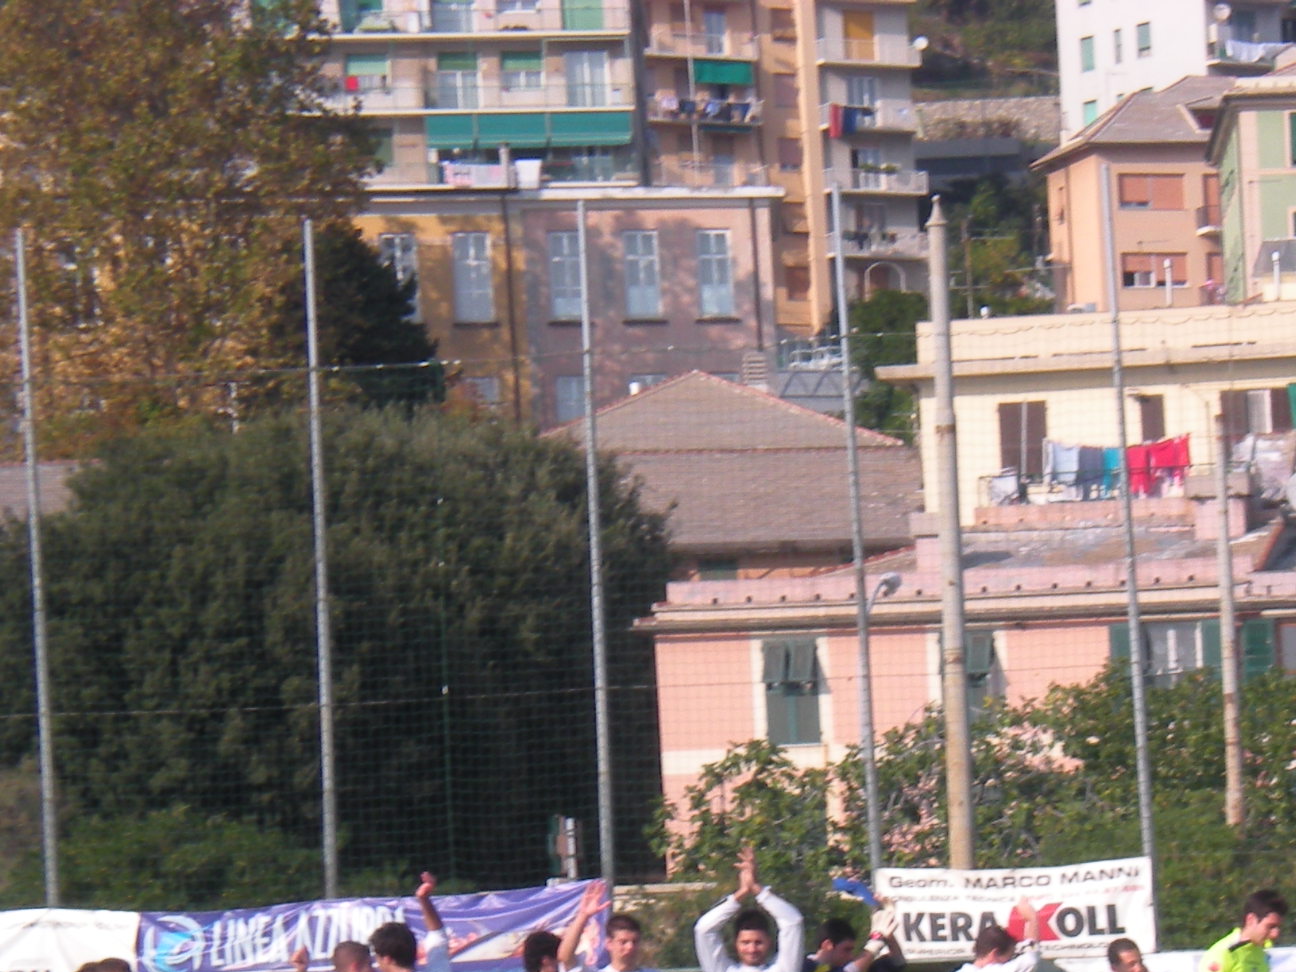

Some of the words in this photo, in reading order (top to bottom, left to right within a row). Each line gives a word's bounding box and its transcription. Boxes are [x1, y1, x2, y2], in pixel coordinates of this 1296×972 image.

[964, 875, 1050, 890] MARCO
[1060, 865, 1141, 885] MANNI
[209, 915, 290, 968] LINEA
